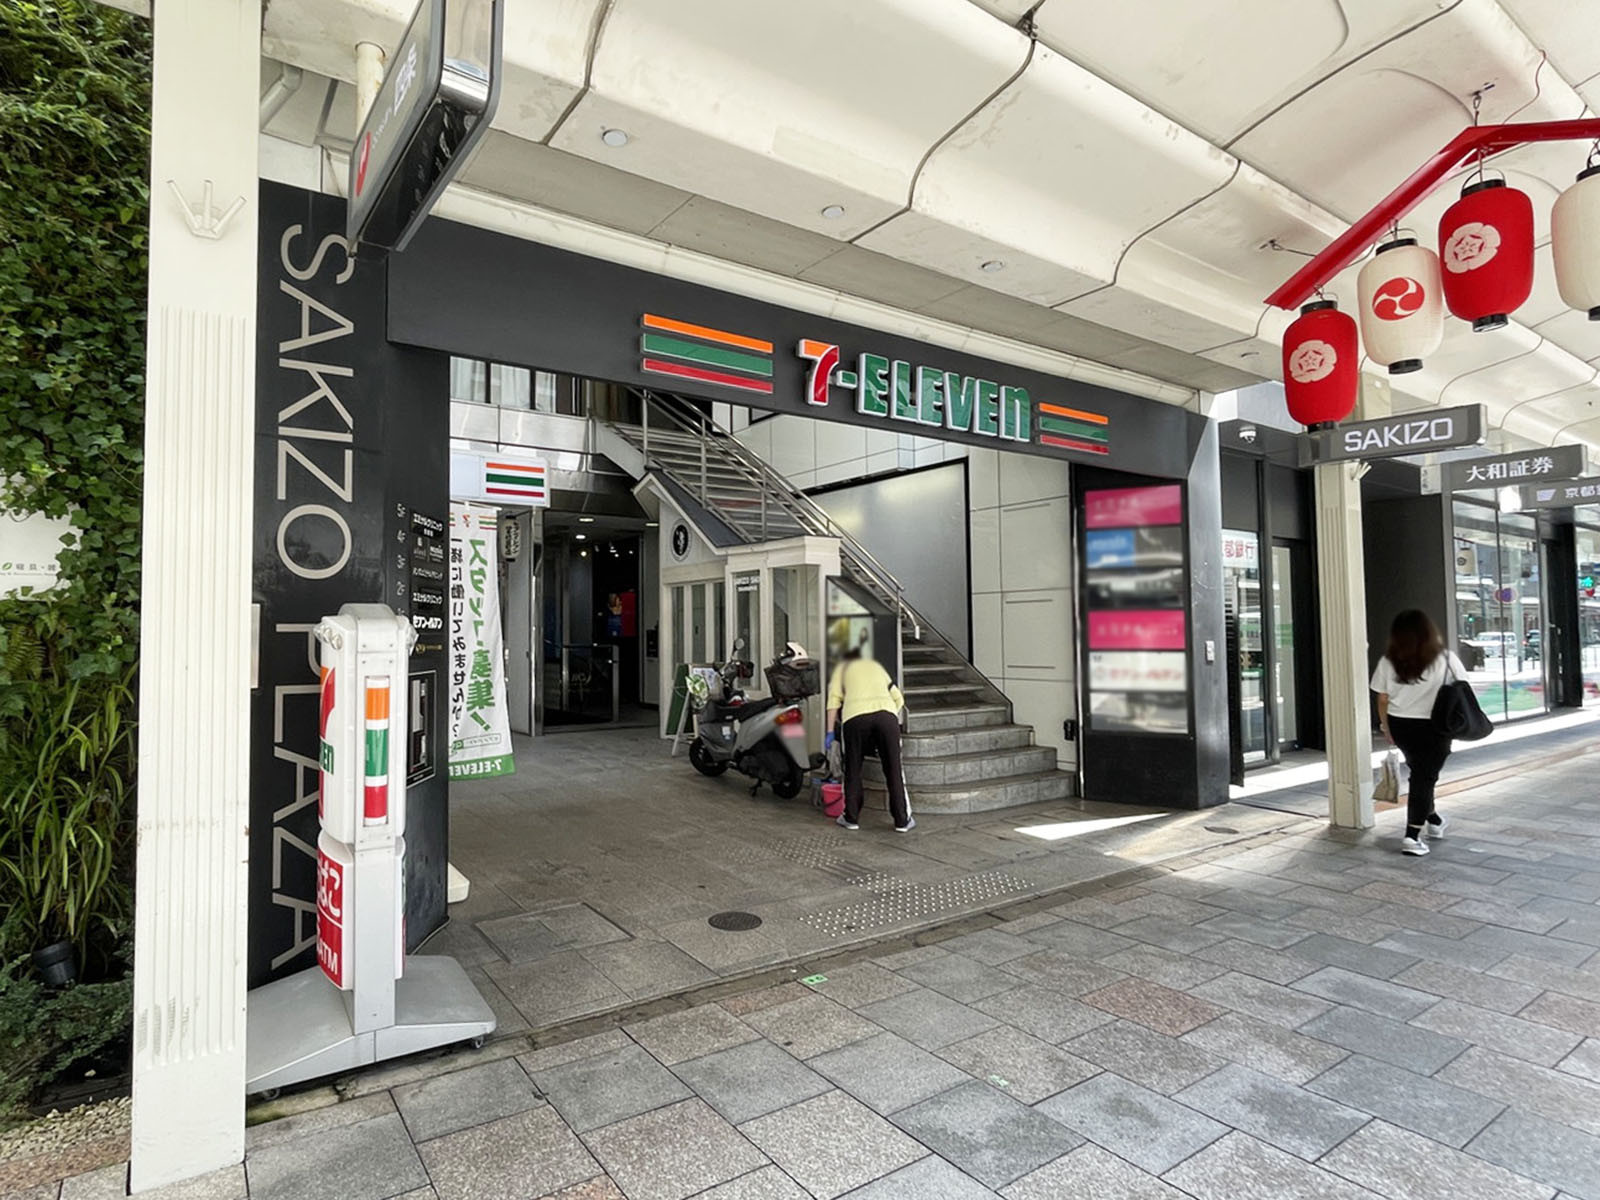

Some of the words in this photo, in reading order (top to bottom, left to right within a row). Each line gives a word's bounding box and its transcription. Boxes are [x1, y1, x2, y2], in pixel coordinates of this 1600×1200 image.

[276, 223, 355, 580] SAKIZO
[1344, 417, 1453, 452] SAKIZO
[1465, 456, 1554, 483] 大和証券
[1223, 540, 1256, 560] 都銀行
